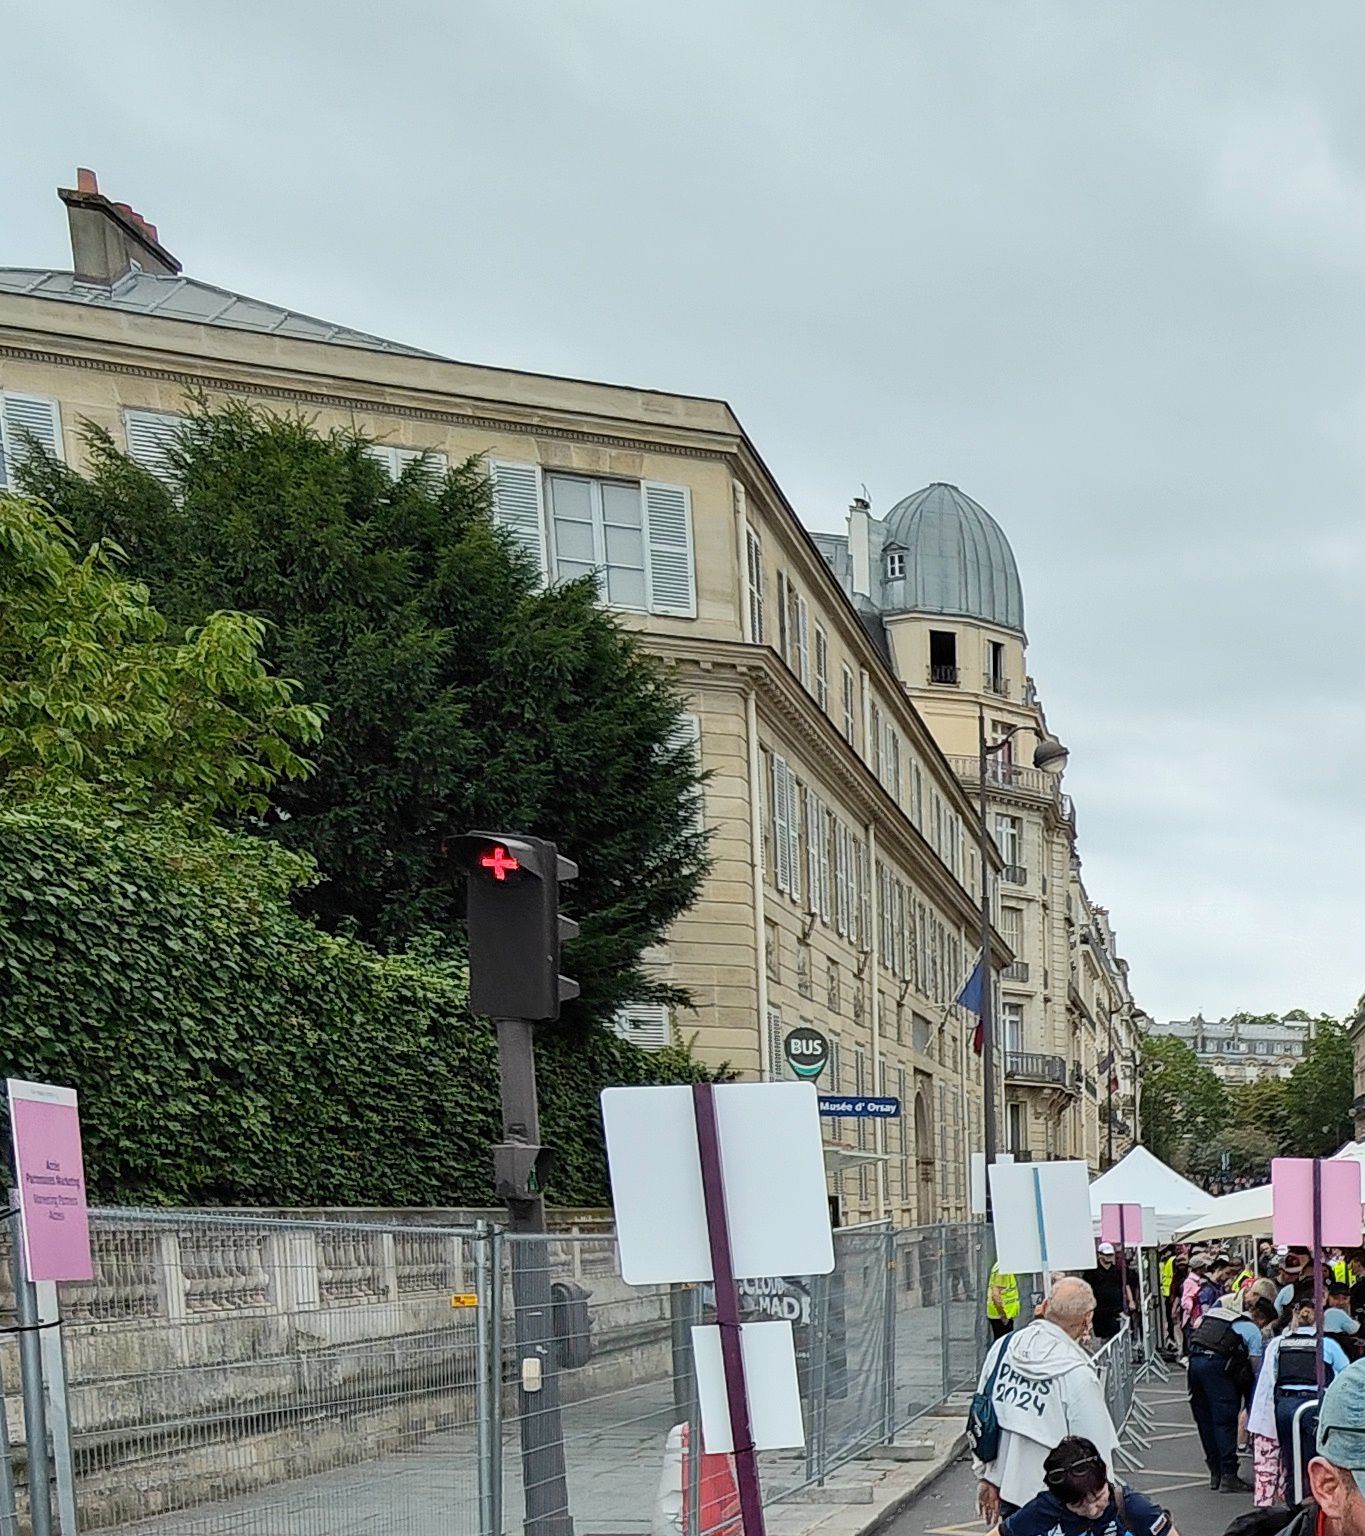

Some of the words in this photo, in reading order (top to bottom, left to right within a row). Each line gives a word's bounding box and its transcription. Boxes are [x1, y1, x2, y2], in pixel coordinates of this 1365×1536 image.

[791, 1039, 822, 1055] BUS
[867, 1103, 897, 1114] Orsay
[994, 1383, 1046, 1416] 2024
